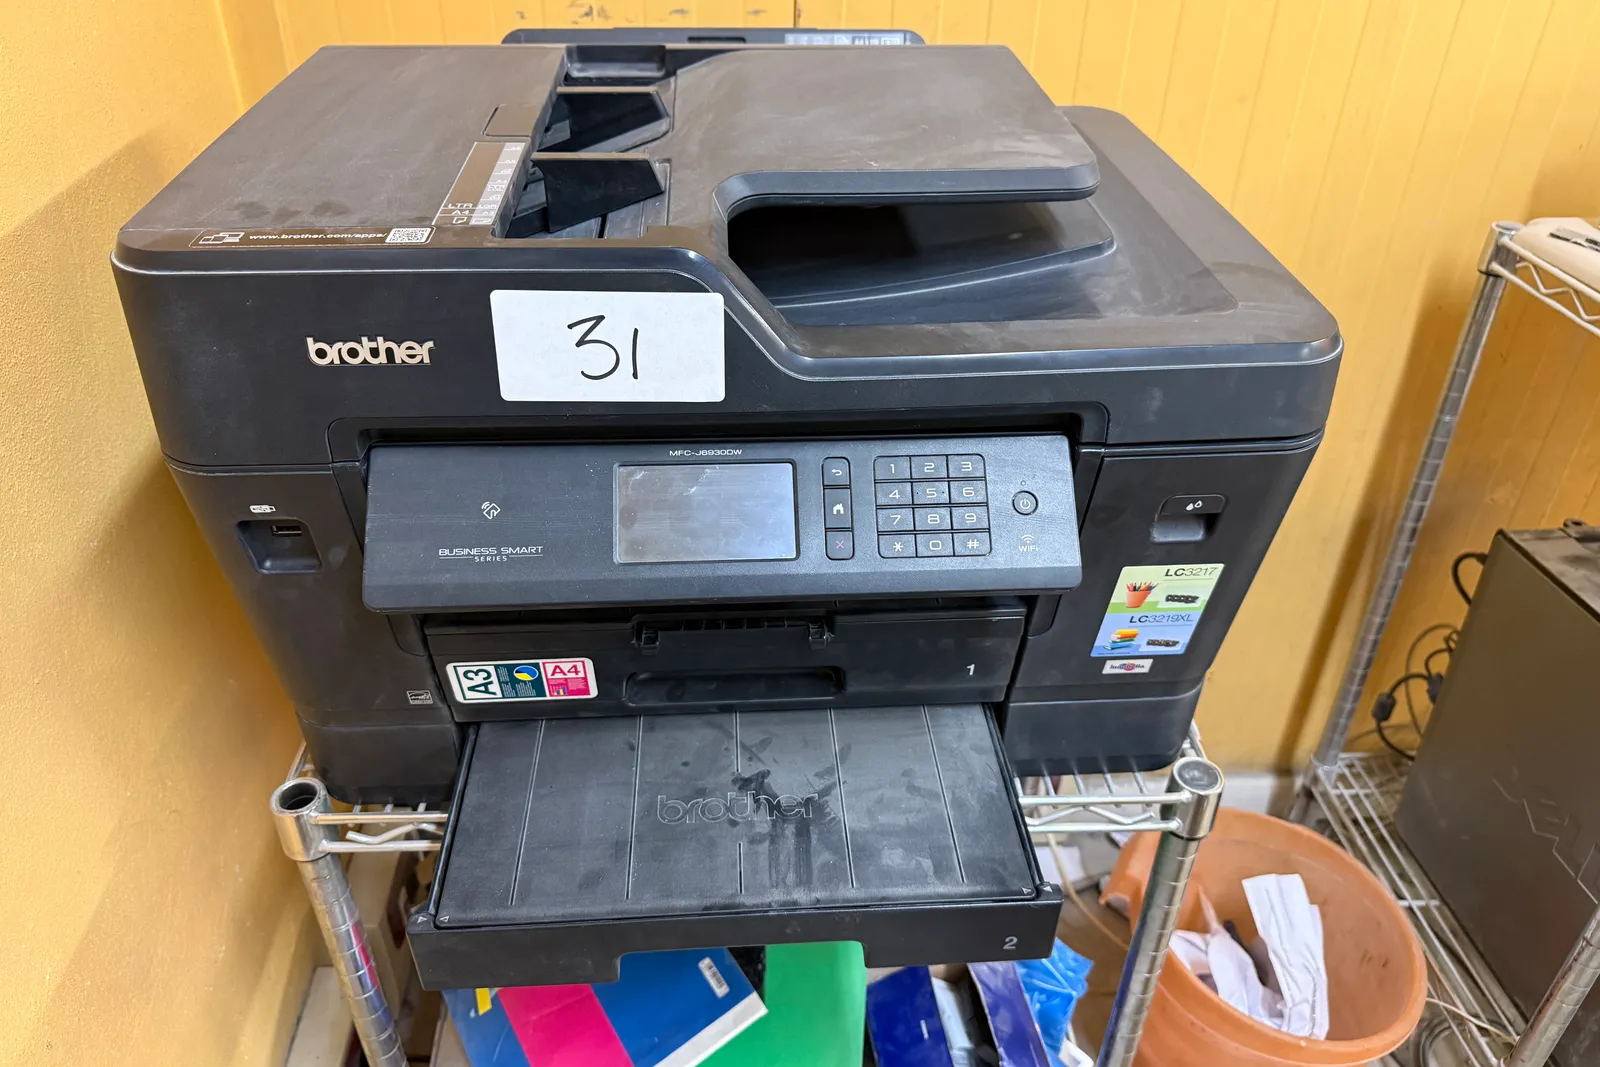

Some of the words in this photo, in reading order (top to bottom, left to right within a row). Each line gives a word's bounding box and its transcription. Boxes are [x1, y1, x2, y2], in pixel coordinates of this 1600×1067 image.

[249, 232, 386, 240] www.brother.com/apps/
[306, 336, 435, 366] brother
[567, 314, 639, 380] 31
[890, 463, 895, 474] 1
[924, 462, 935, 473] 2
[961, 461, 972, 472] 3
[889, 489, 900, 499] 4
[926, 488, 937, 498] 5
[962, 487, 975, 497] 6
[890, 515, 901, 525] 7
[927, 514, 940, 524] 8
[964, 513, 977, 523] 9
[439, 547, 497, 556] BUSINESS
[501, 546, 543, 554] SMART
[929, 540, 942, 550] 0
[1164, 567, 1218, 577] LC3217
[1129, 614, 1193, 624] LC3219XL
[966, 663, 976, 676] 1
[463, 668, 497, 696] A3
[550, 664, 581, 677] A4
[657, 790, 819, 825] brother
[1003, 936, 1018, 950] 2
